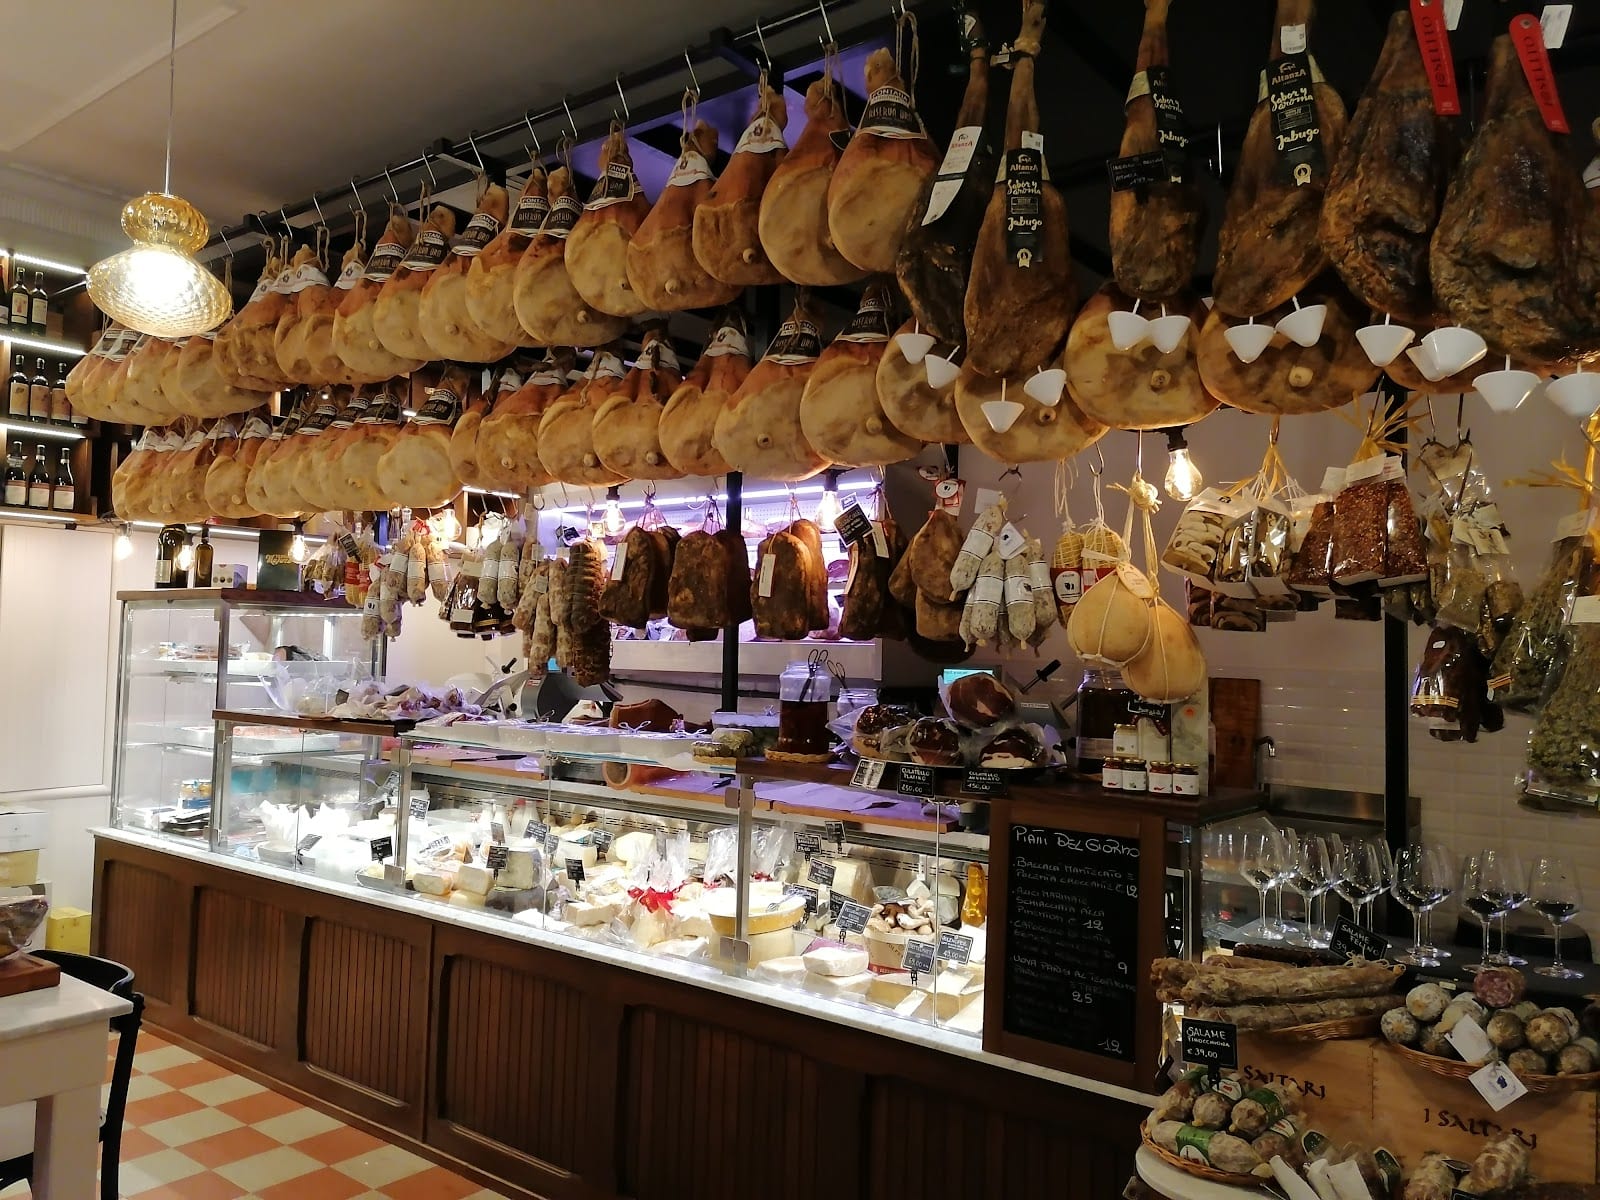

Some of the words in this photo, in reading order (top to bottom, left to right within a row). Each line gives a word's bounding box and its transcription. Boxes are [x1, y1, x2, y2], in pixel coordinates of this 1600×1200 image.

[1158, 129, 1189, 147] Jabugo
[1275, 127, 1320, 151] Jabugo
[1007, 215, 1042, 231] Jabugo
[1054, 832, 1083, 852] DEL
[1126, 884, 1139, 899] 12
[1082, 919, 1104, 931] 12
[1341, 924, 1370, 945] SALAME
[1117, 961, 1128, 975] 9
[1071, 990, 1093, 1004] 25
[1187, 1026, 1227, 1041] SALAME
[1193, 1047, 1218, 1059] 39,00
